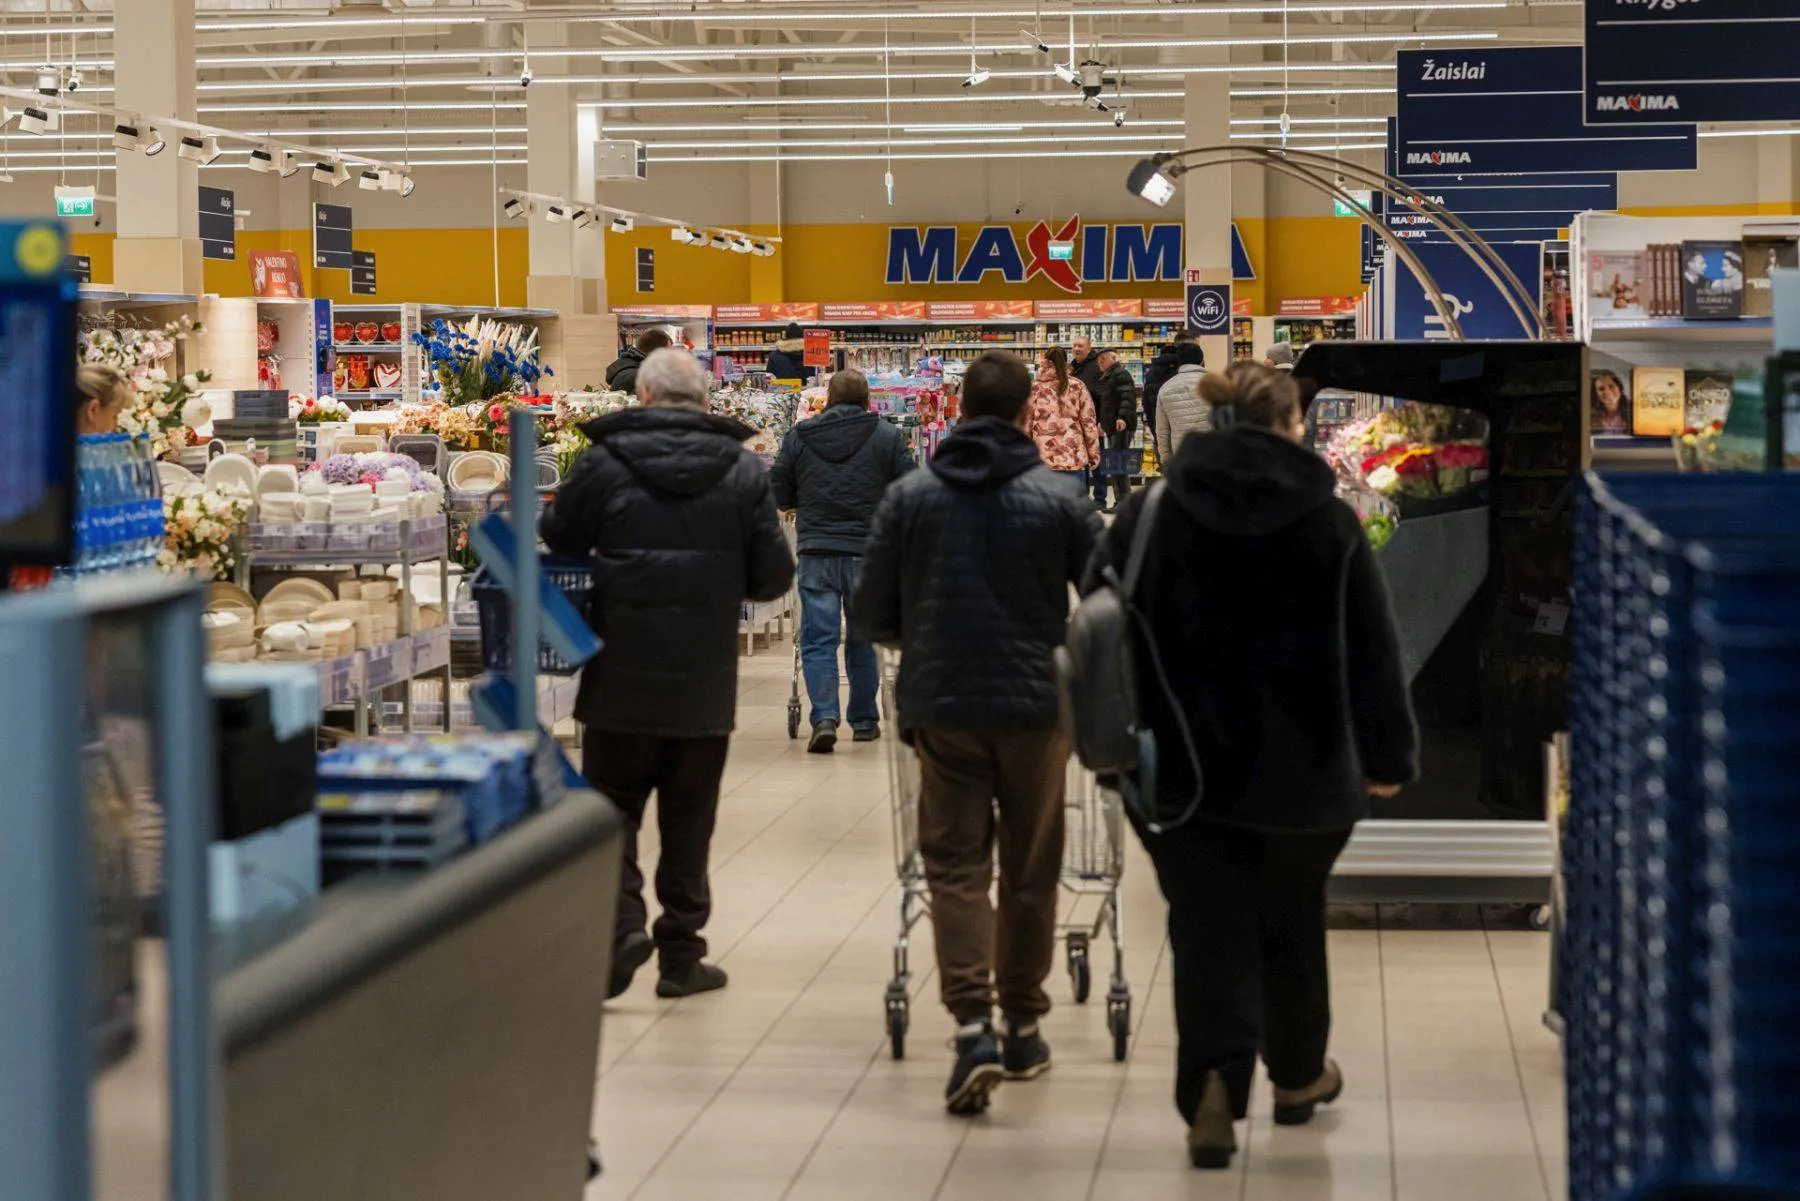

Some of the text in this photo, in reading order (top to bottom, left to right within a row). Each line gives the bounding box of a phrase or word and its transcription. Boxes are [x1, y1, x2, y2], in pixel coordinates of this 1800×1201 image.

[1421, 59, 1486, 80] Žaislai
[1597, 93, 1680, 112] MAXIMA
[1406, 151, 1472, 165] MAXIMA
[1197, 305, 1219, 315] WiFi
